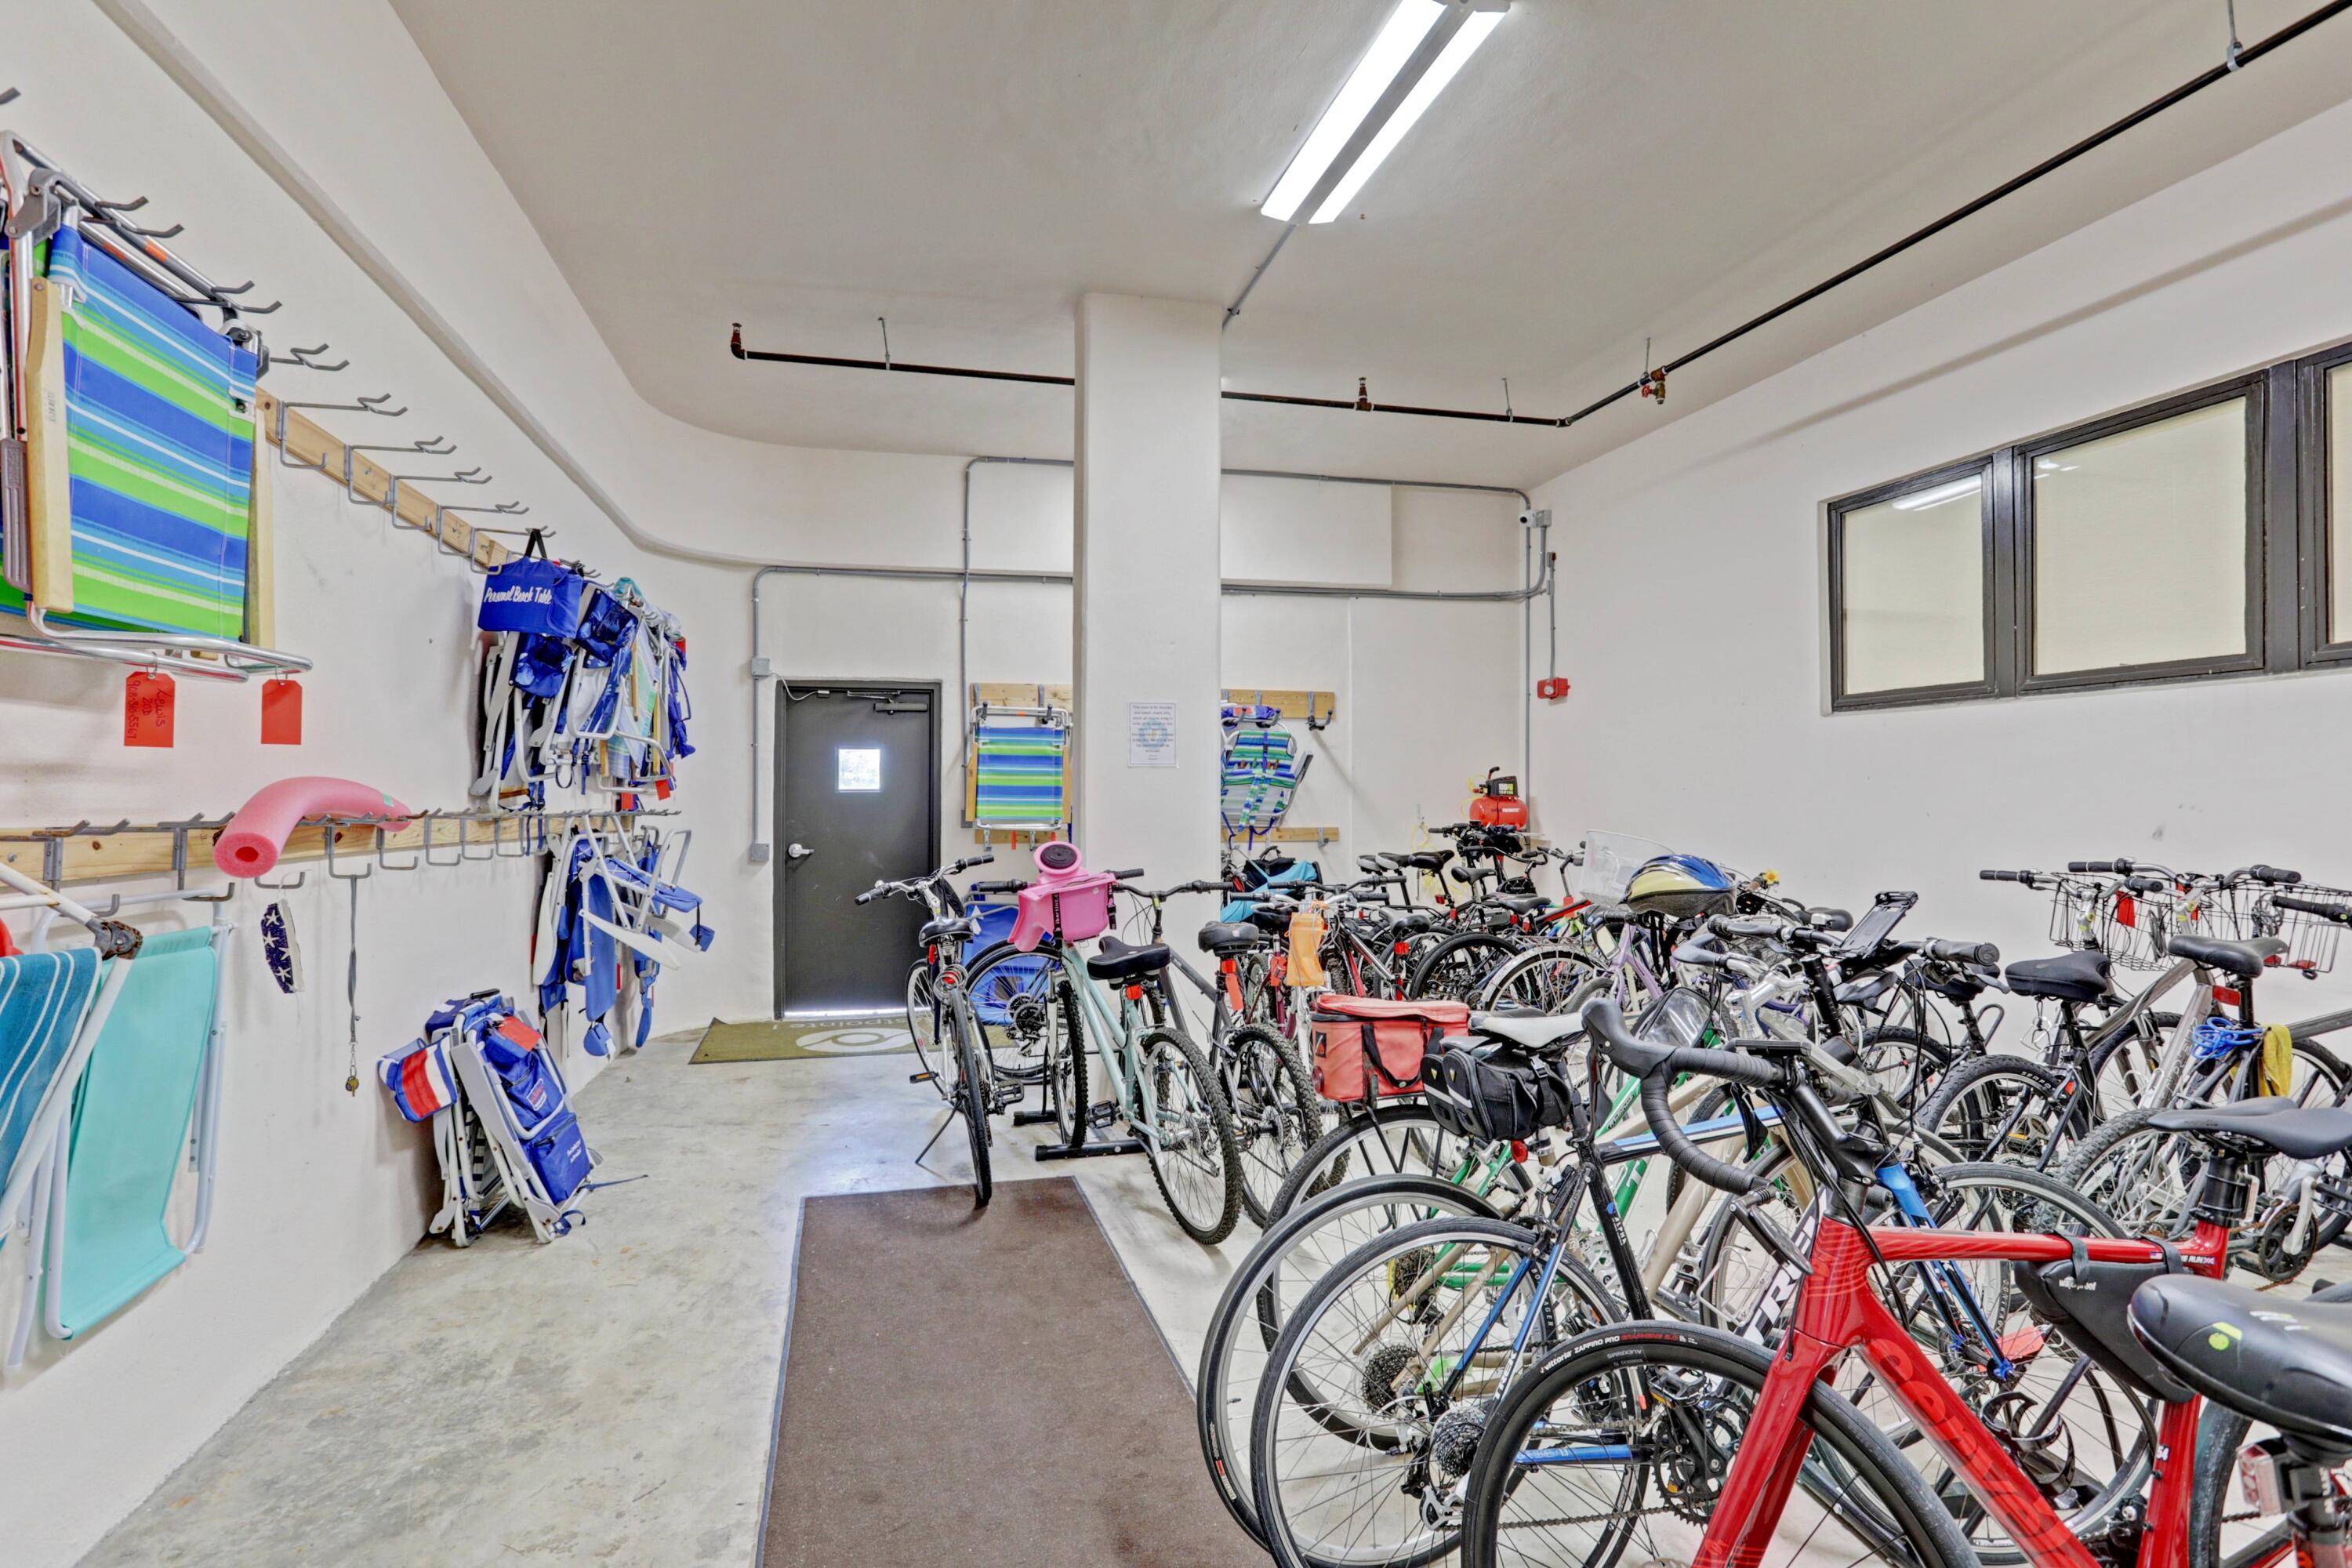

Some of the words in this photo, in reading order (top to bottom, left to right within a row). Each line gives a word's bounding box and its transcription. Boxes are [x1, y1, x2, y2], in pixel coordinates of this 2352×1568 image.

[484, 585, 516, 603] Personal
[512, 585, 534, 603] Beach
[534, 586, 553, 604] Table
[154, 688, 172, 727] Lewis
[1606, 1348, 1644, 1359] ALEXRIMS
[1493, 1350, 1518, 1401] TREK
[2156, 1446, 2170, 1460] 54
